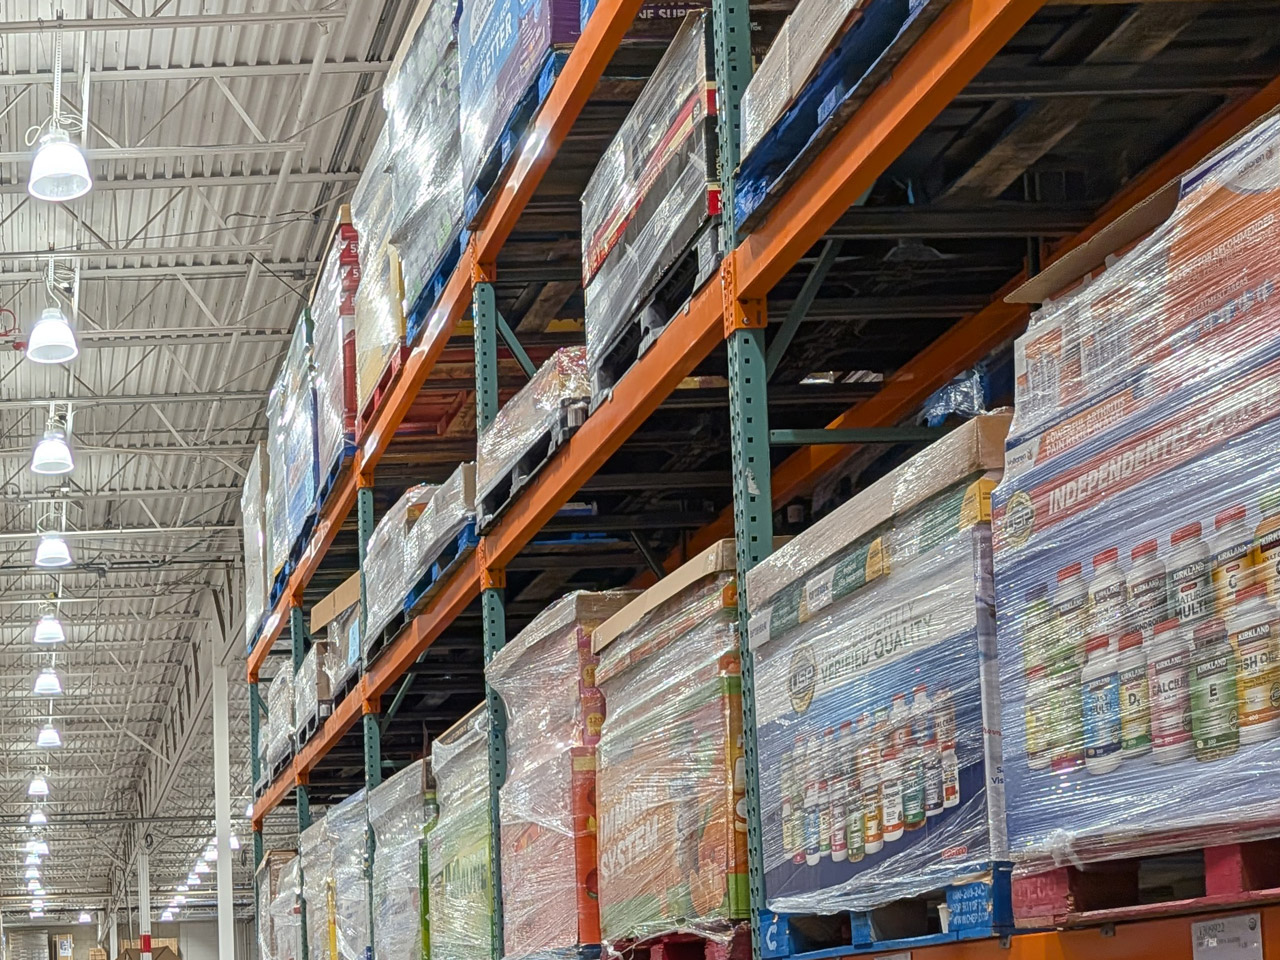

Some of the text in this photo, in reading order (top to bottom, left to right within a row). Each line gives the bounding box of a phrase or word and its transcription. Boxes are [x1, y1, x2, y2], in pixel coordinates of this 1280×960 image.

[1173, 563, 1205, 580] KIRKLAND
[873, 614, 933, 659] QUALITY
[1238, 624, 1271, 641] KIRKLAND
[1197, 658, 1228, 675] KIRKLAND
[1209, 683, 1218, 698] E
